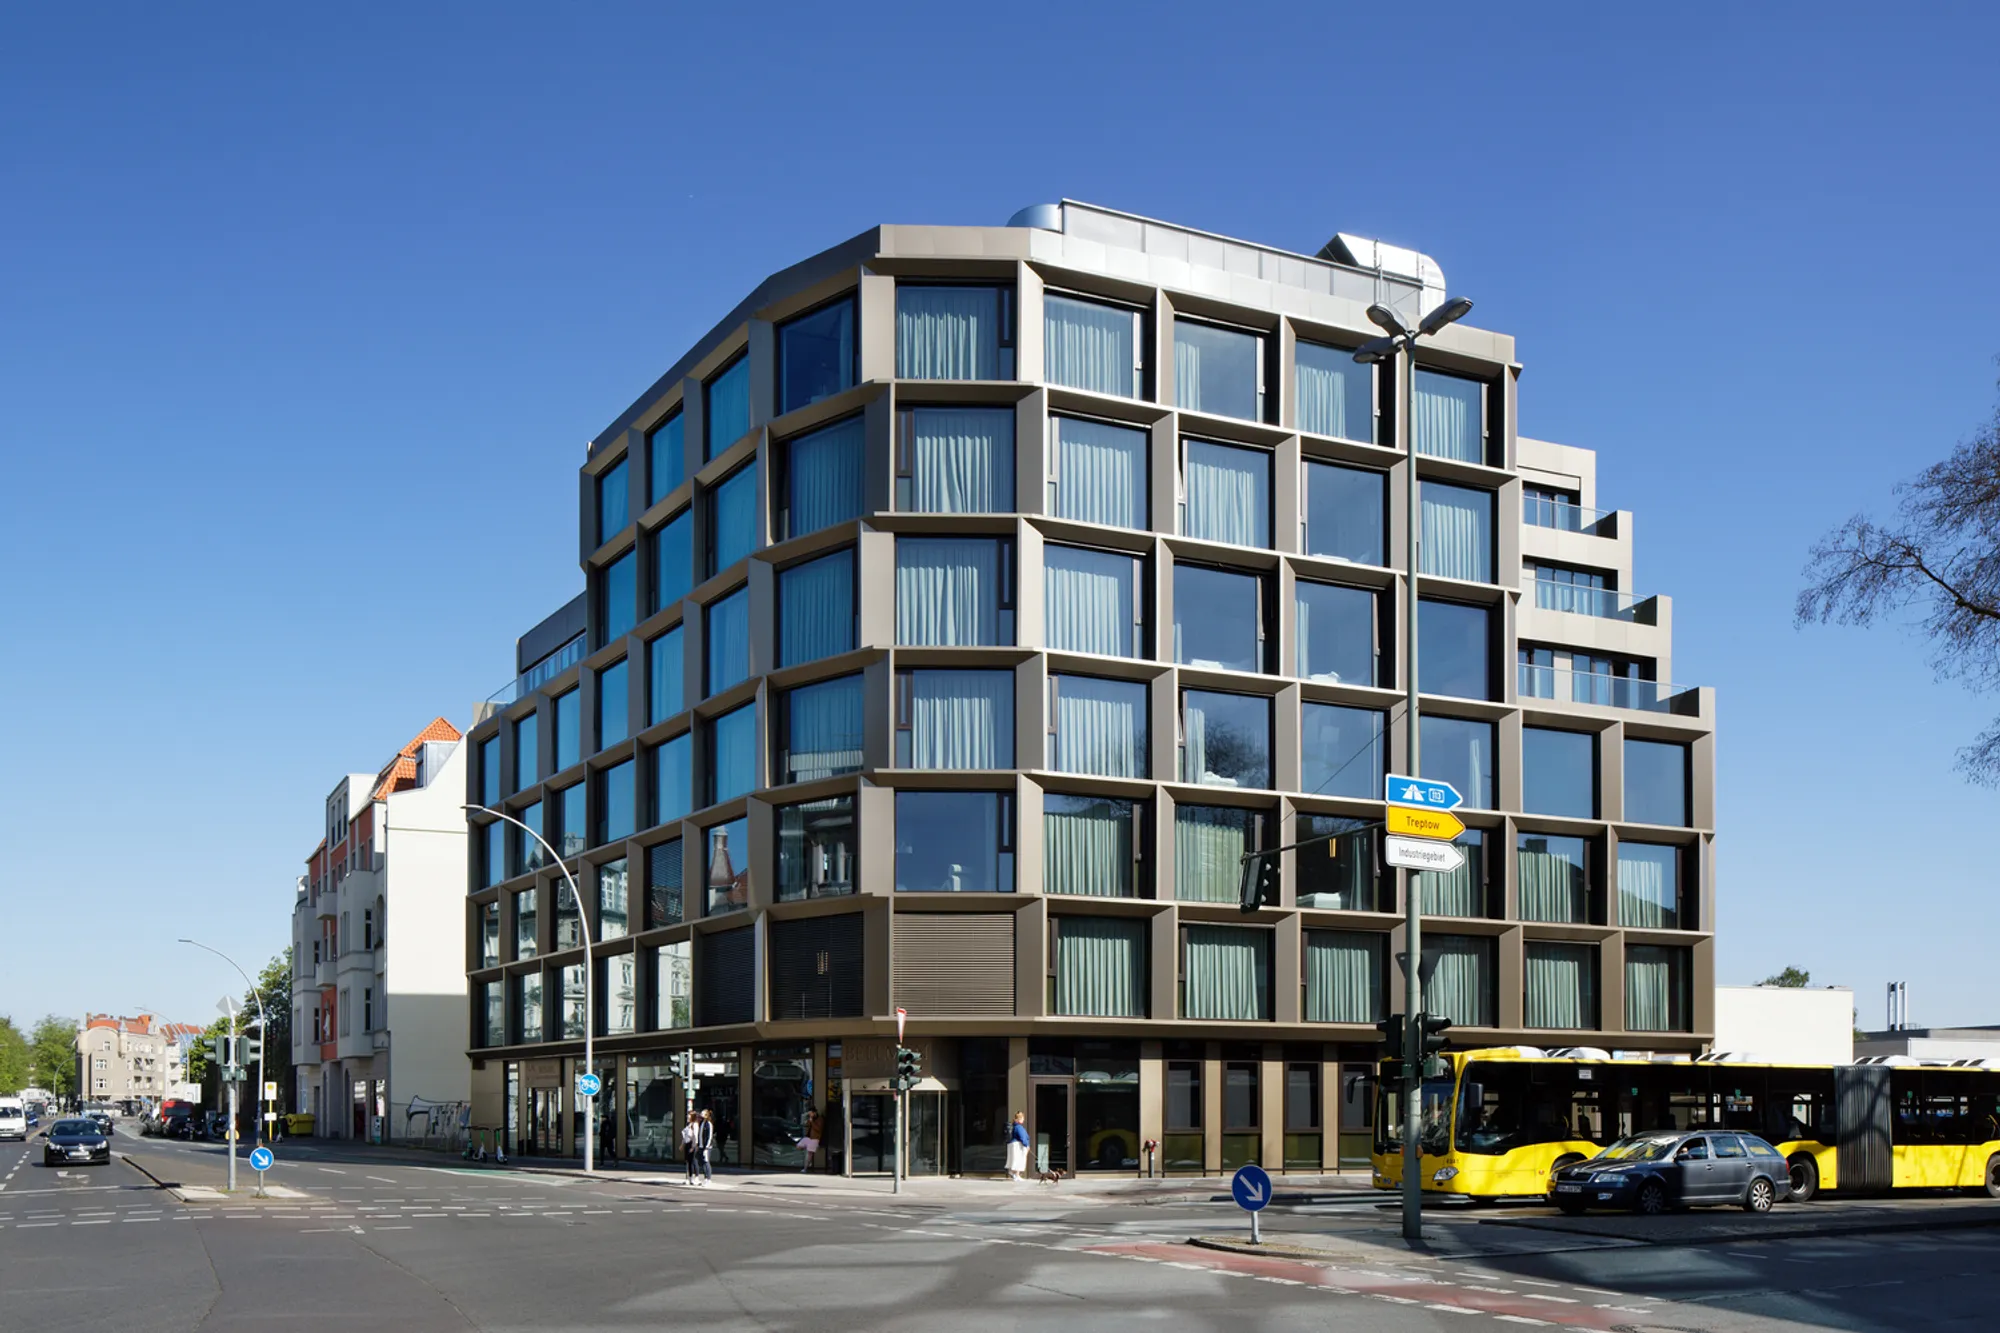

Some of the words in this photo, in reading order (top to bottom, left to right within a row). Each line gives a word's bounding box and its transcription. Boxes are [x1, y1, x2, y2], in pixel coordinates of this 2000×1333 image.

[1406, 815, 1440, 830] Treptow
[1398, 846, 1446, 863] Industriegebiet
[845, 1044, 929, 1062] BELLMN
